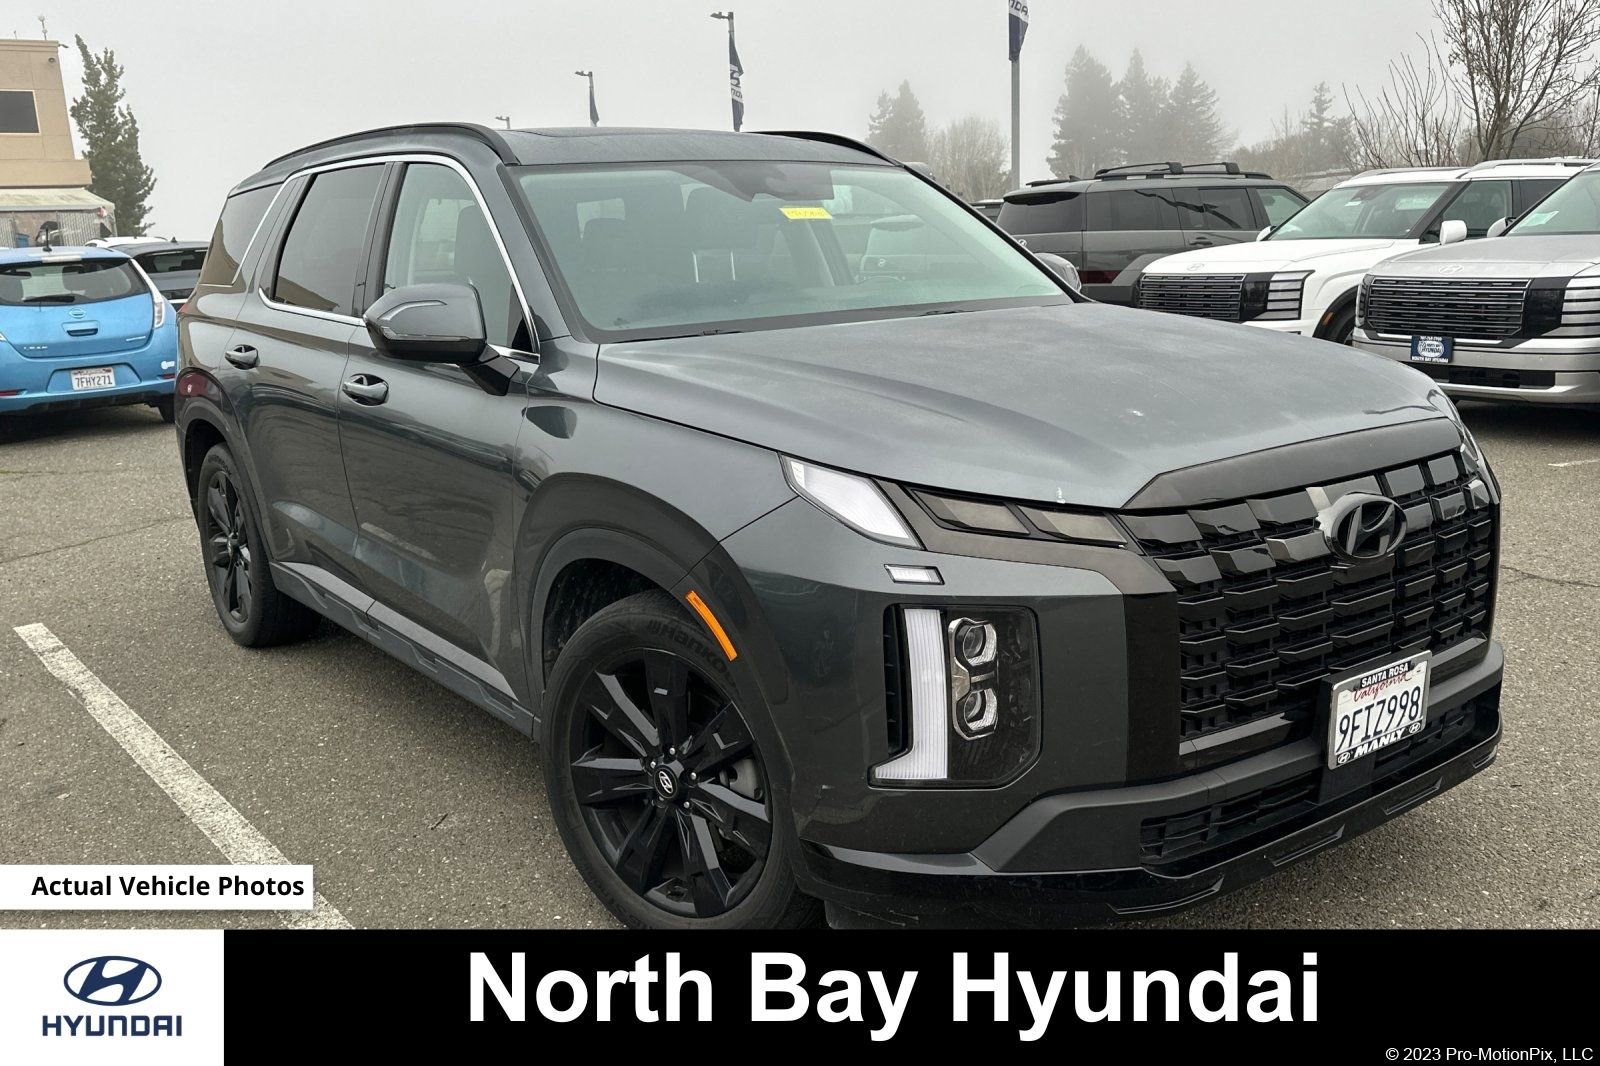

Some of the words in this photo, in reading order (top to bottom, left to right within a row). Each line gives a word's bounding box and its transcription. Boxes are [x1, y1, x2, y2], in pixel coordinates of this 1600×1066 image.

[75, 375, 112, 388] 7FHY271
[1361, 672, 1387, 688] SANTA
[1388, 662, 1409, 677] ROSA
[1335, 686, 1421, 753] 9FIZ998
[1354, 727, 1406, 759] MANLY
